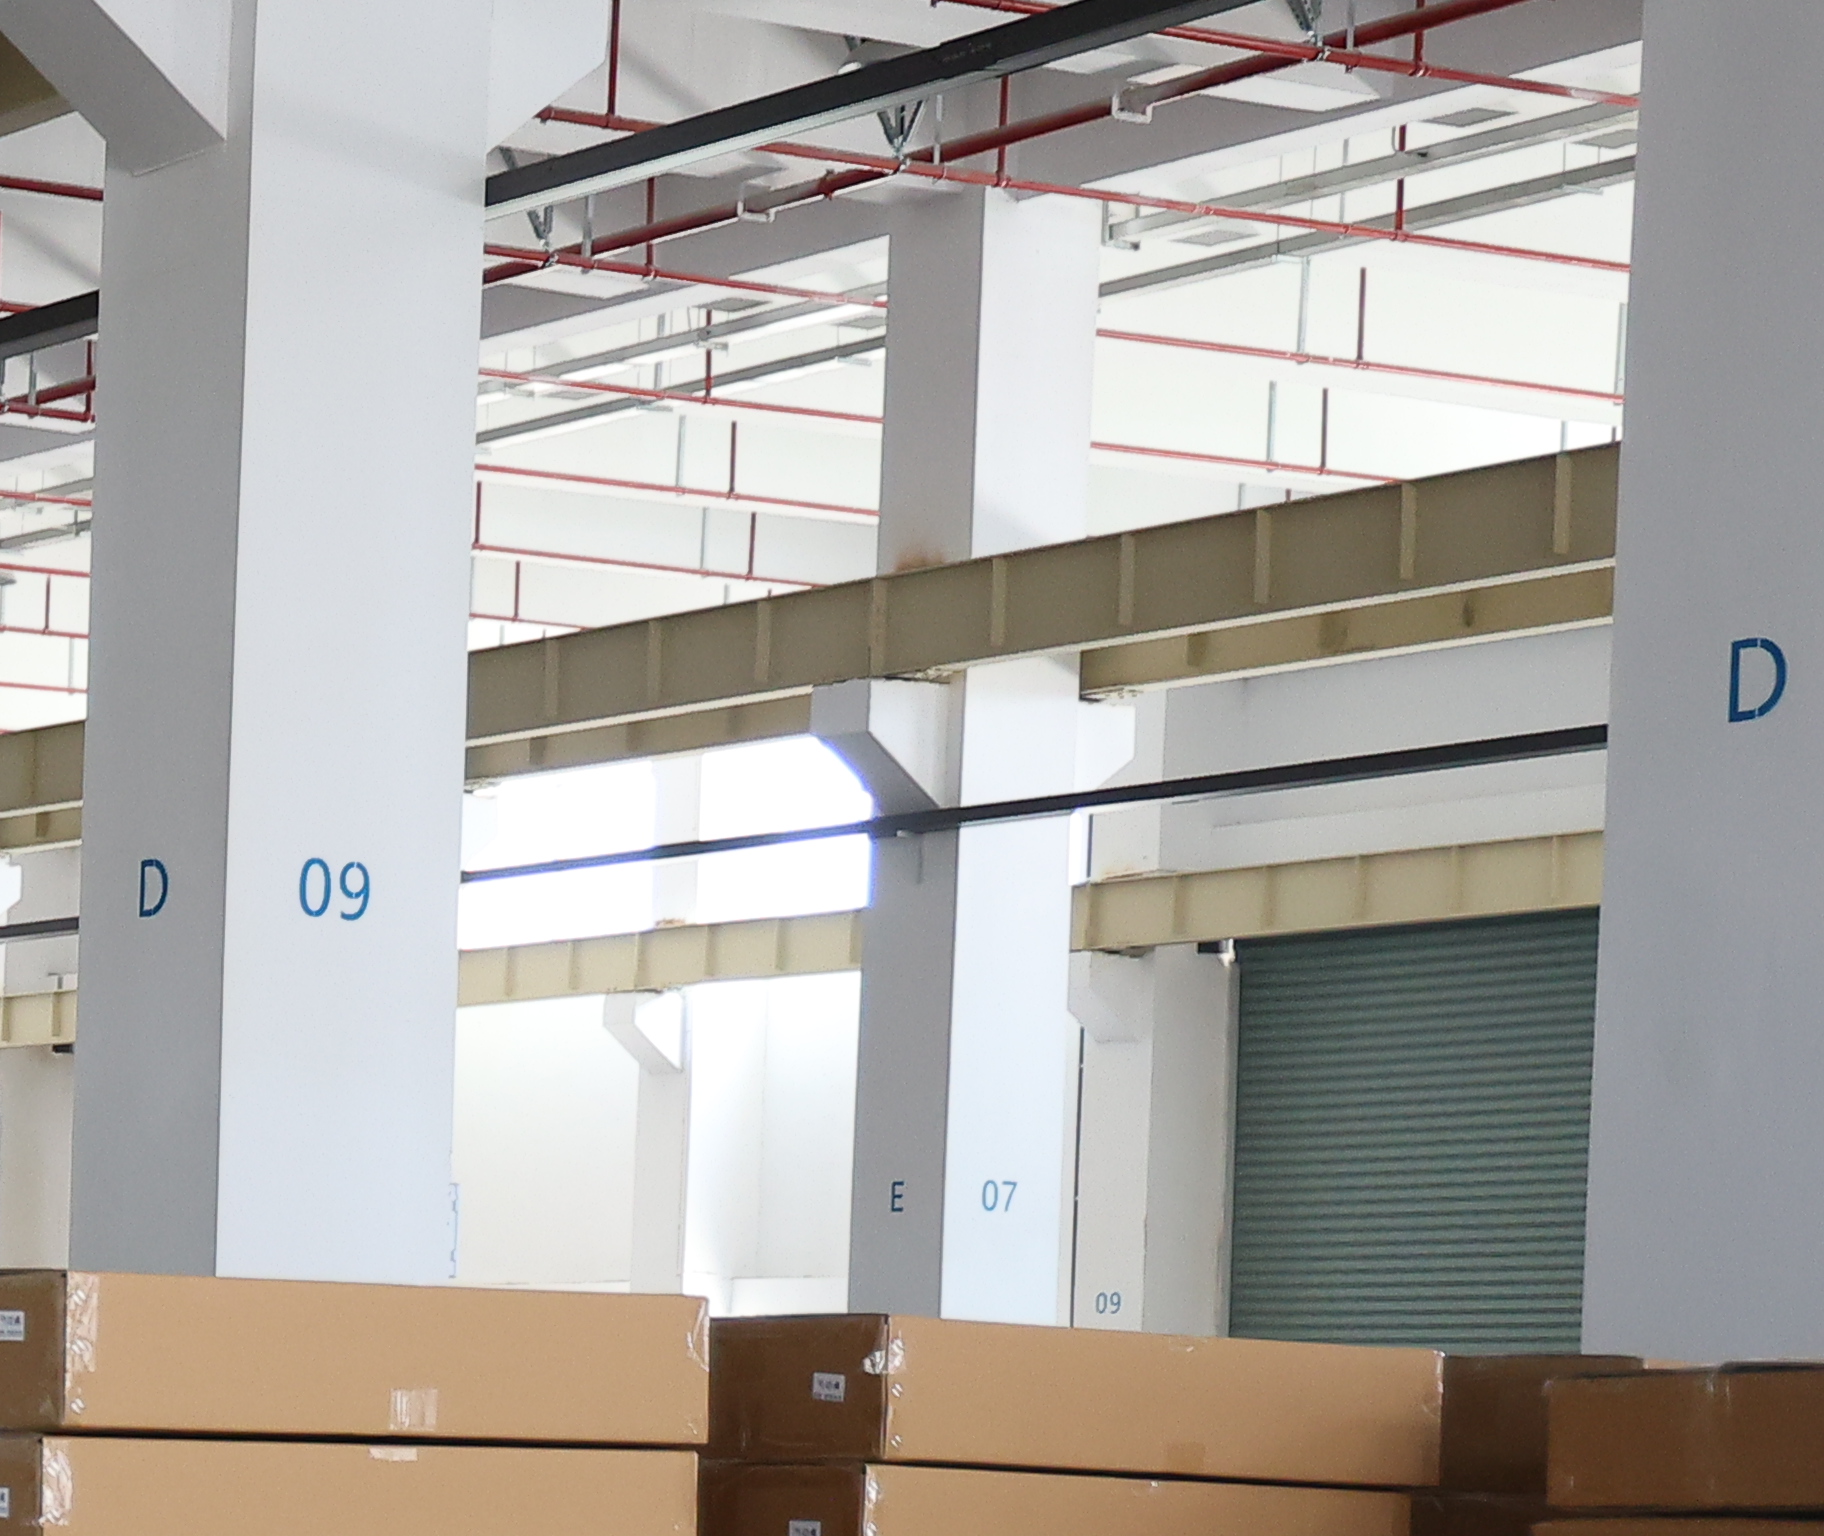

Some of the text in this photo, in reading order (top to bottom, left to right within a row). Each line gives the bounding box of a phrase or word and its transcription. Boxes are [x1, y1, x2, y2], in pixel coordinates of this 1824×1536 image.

[1728, 637, 1787, 723] D
[139, 858, 169, 918] D
[299, 857, 370, 921] 09
[891, 1180, 905, 1213] E
[981, 1179, 1018, 1212] 07
[1095, 1291, 1122, 1315] 09
